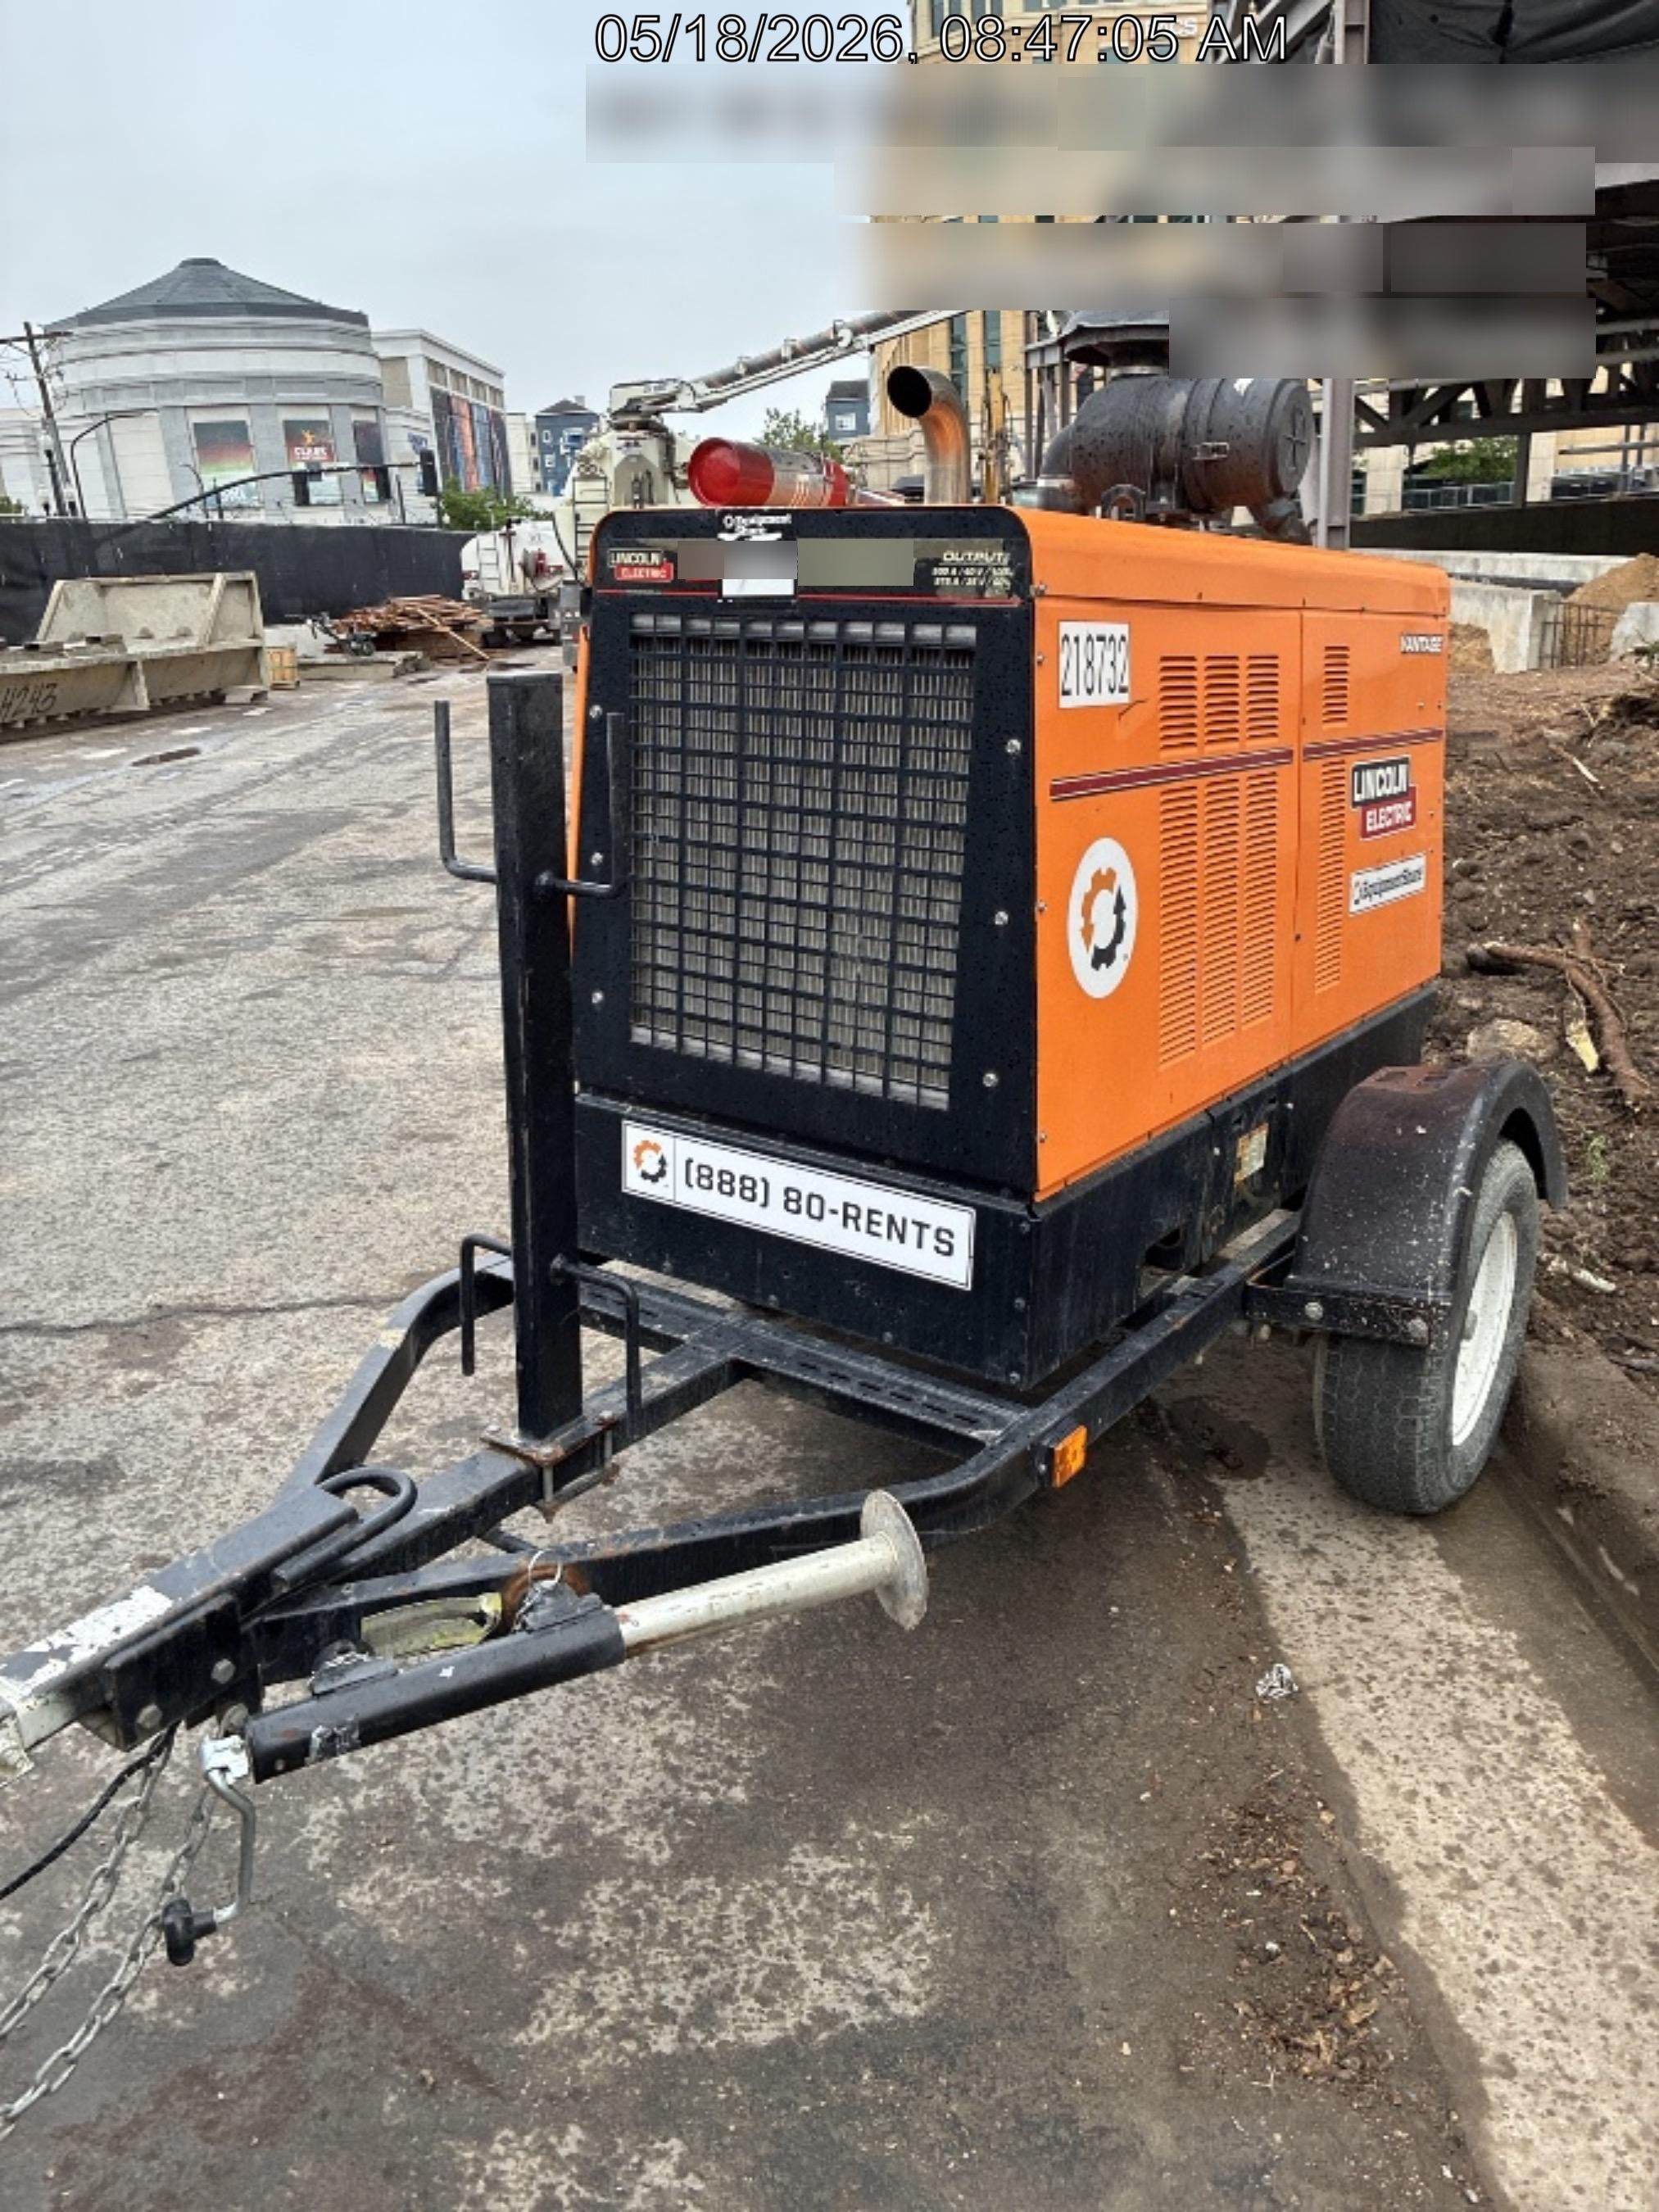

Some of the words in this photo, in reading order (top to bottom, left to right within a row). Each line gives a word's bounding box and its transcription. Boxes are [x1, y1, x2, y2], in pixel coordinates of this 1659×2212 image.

[610, 551, 661, 565] LINCOLN
[942, 551, 1004, 562] OUTPUT
[1061, 632, 1129, 696] 218732
[1353, 762, 1409, 803] LINCOLN
[1366, 800, 1413, 832] ELECTRIC
[684, 1156, 770, 1208] (888)
[782, 1186, 956, 1258] 80-RENTS
